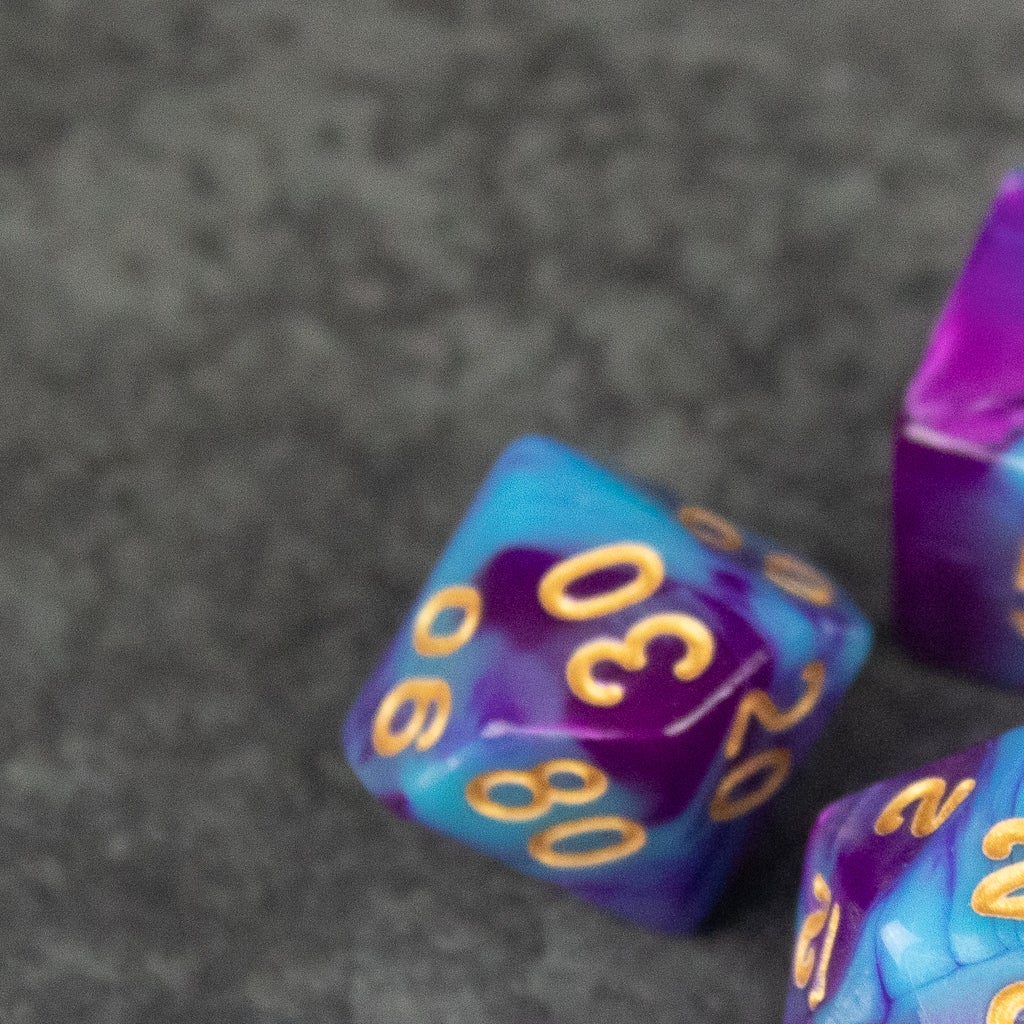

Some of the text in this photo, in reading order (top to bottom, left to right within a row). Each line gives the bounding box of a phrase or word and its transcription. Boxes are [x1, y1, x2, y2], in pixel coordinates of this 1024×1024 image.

[537, 541, 715, 707] 30
[710, 659, 826, 822] 20
[873, 776, 976, 838] 2
[465, 758, 648, 870] 80
